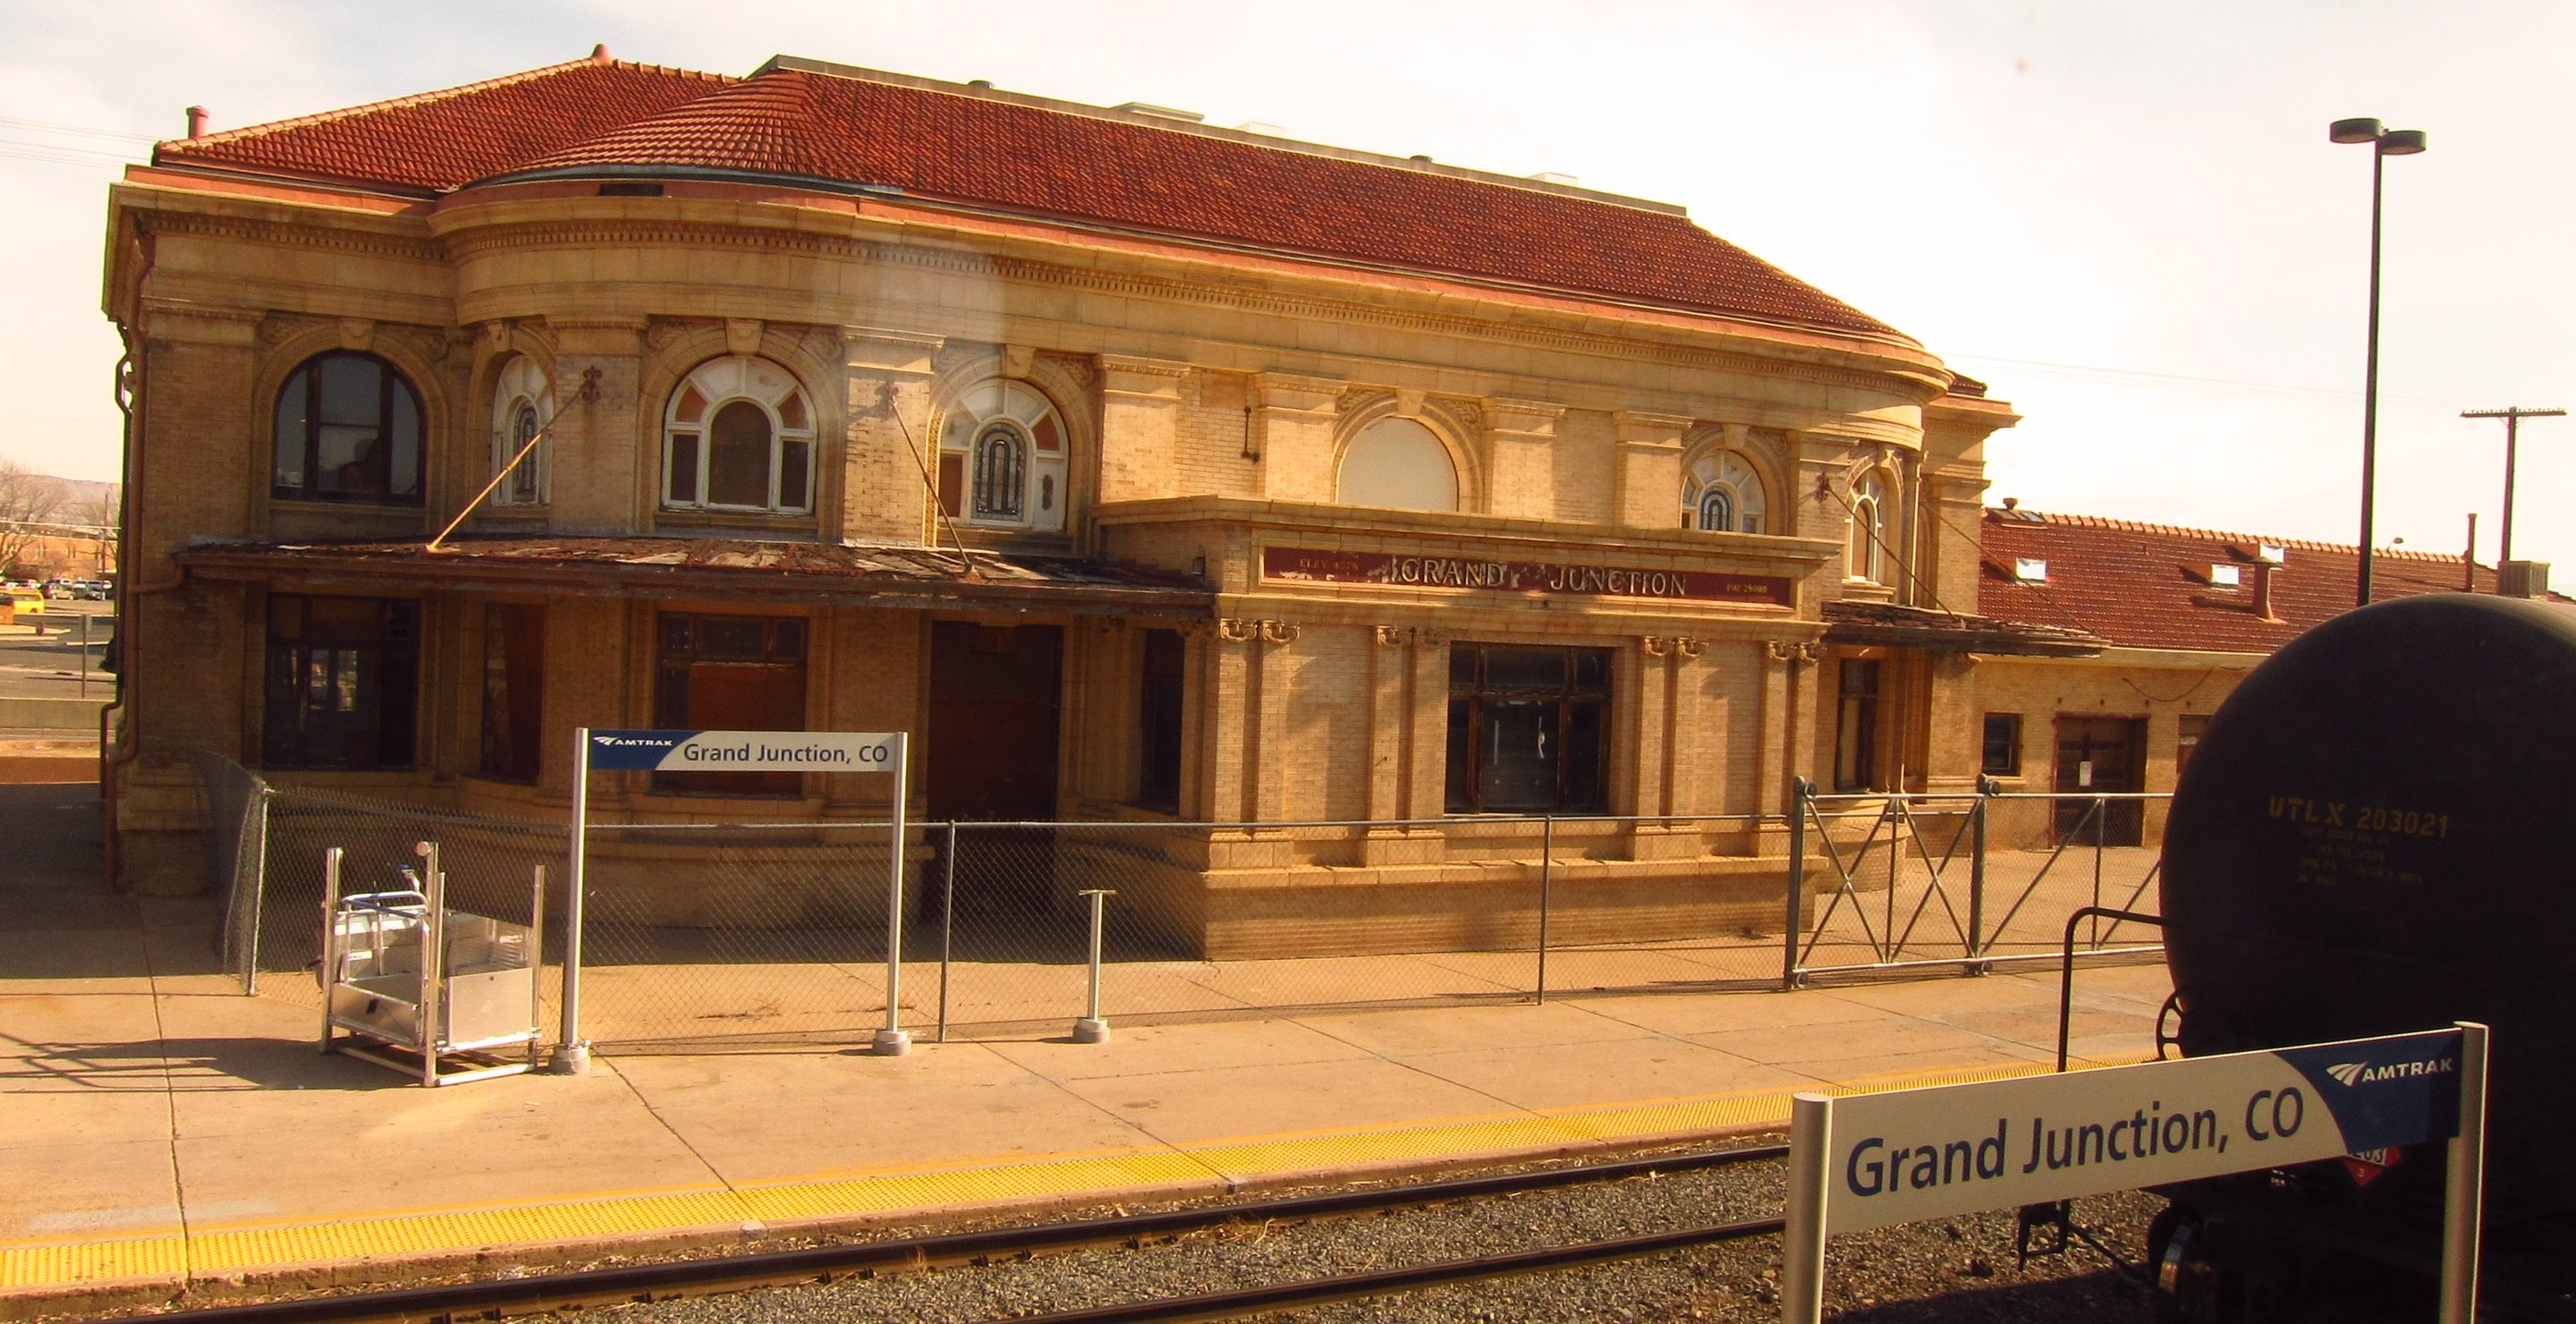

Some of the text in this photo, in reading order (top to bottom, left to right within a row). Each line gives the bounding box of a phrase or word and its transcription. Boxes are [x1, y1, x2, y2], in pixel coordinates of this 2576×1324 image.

[1401, 558, 1687, 596] GRAND JUNCTION
[614, 739, 673, 747] AMTRAK
[684, 743, 888, 764] Grand Junction, CO
[2268, 795, 2346, 826] UTLX
[2356, 806, 2449, 837] 203021
[2361, 1058, 2453, 1082] AMTRAK
[1846, 1086, 2305, 1197] Grand Junction, CO
